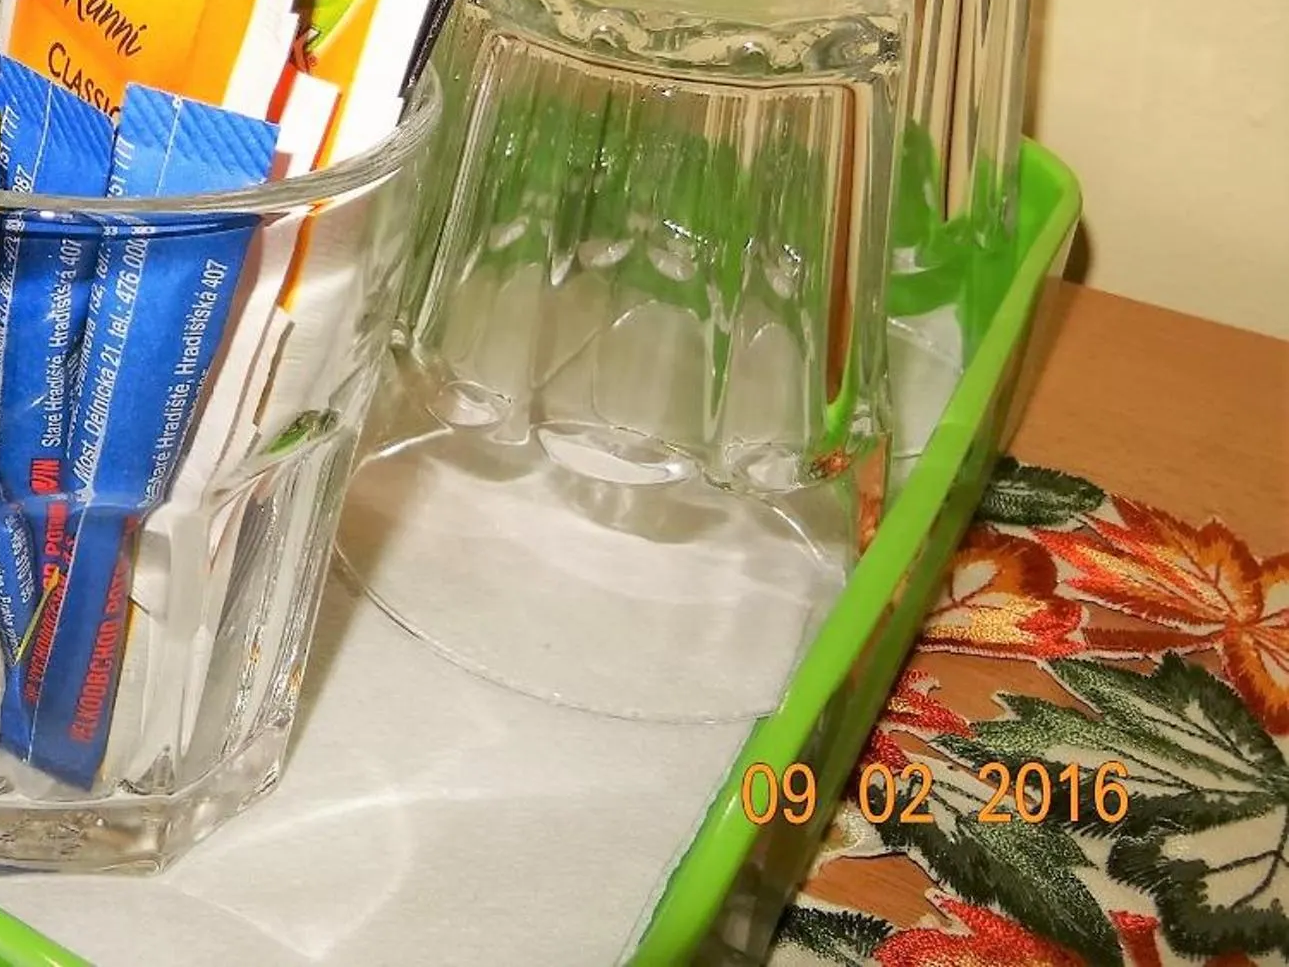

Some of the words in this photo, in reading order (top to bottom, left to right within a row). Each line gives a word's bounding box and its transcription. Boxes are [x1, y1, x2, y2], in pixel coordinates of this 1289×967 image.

[111, 269, 141, 304] 476
[200, 257, 228, 289] 407
[40, 411, 63, 450] Staré
[61, 237, 84, 265] 407
